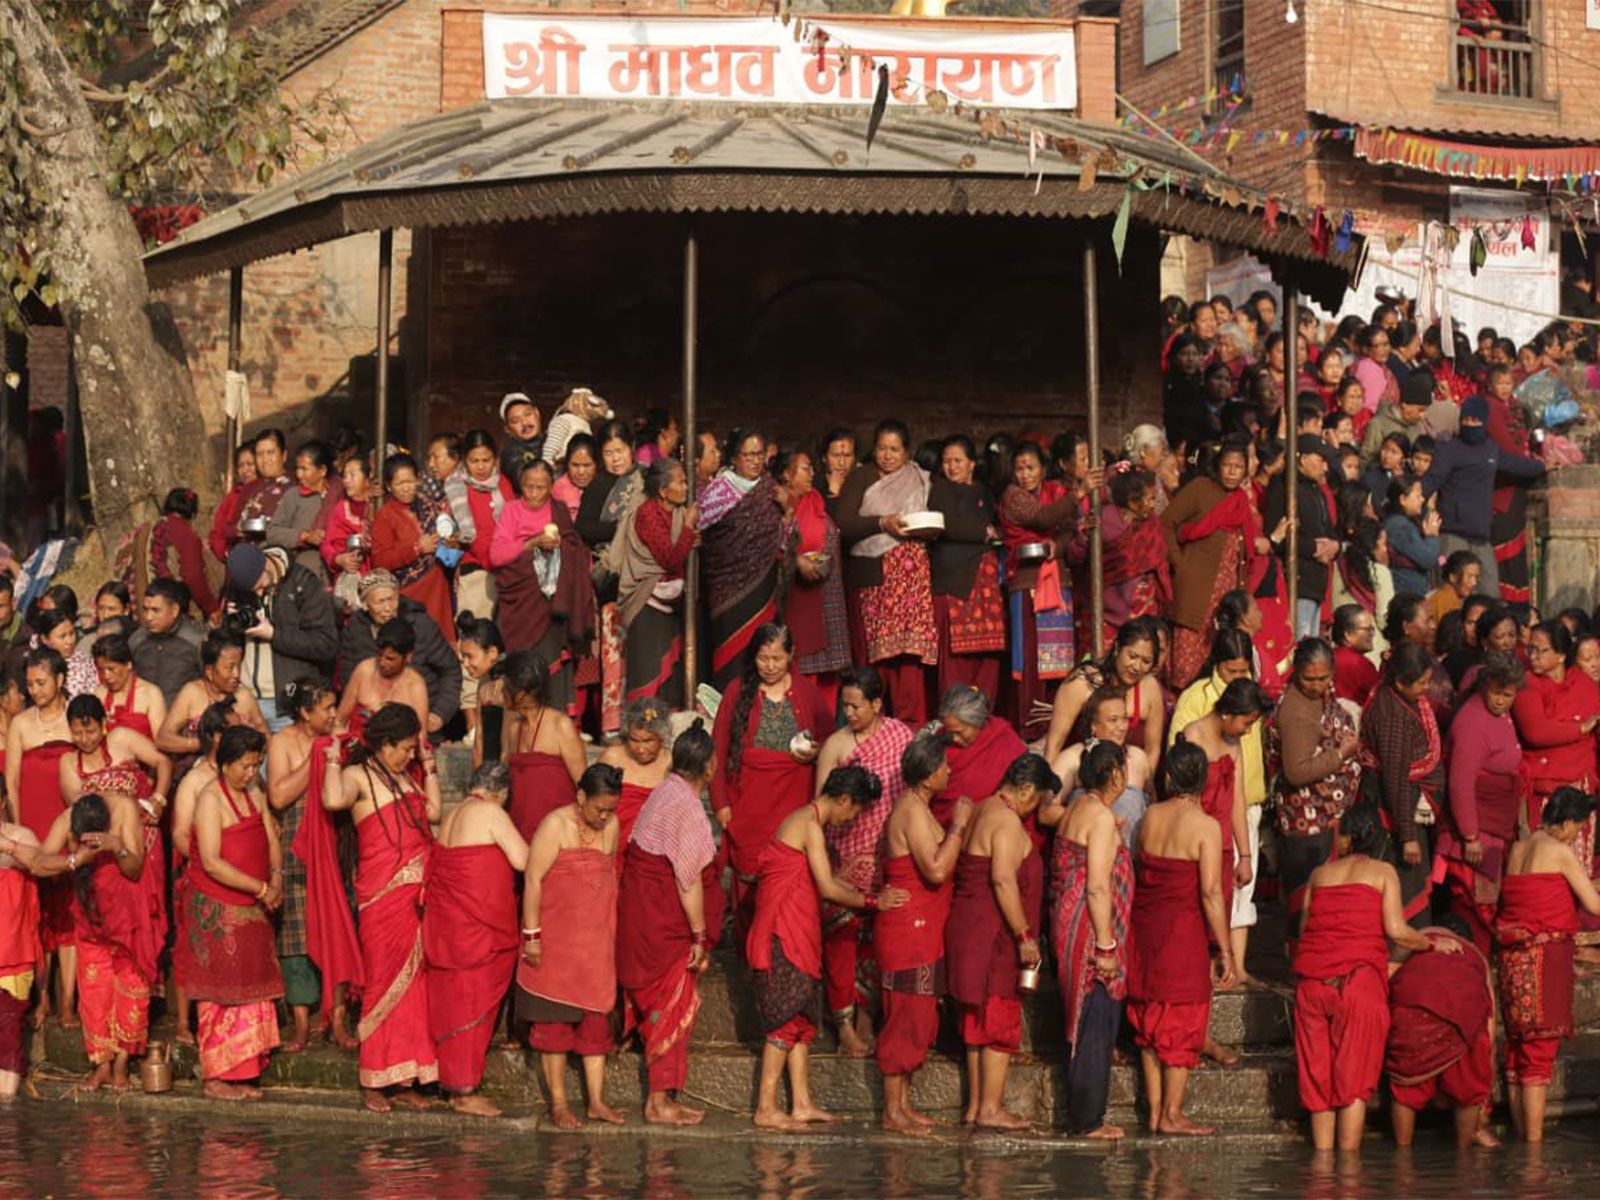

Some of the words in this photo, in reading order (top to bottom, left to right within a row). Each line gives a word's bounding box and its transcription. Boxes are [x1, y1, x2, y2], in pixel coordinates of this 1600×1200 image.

[503, 27, 587, 96] श्री
[608, 44, 780, 97] माधव
[800, 47, 1061, 104] नारायण
